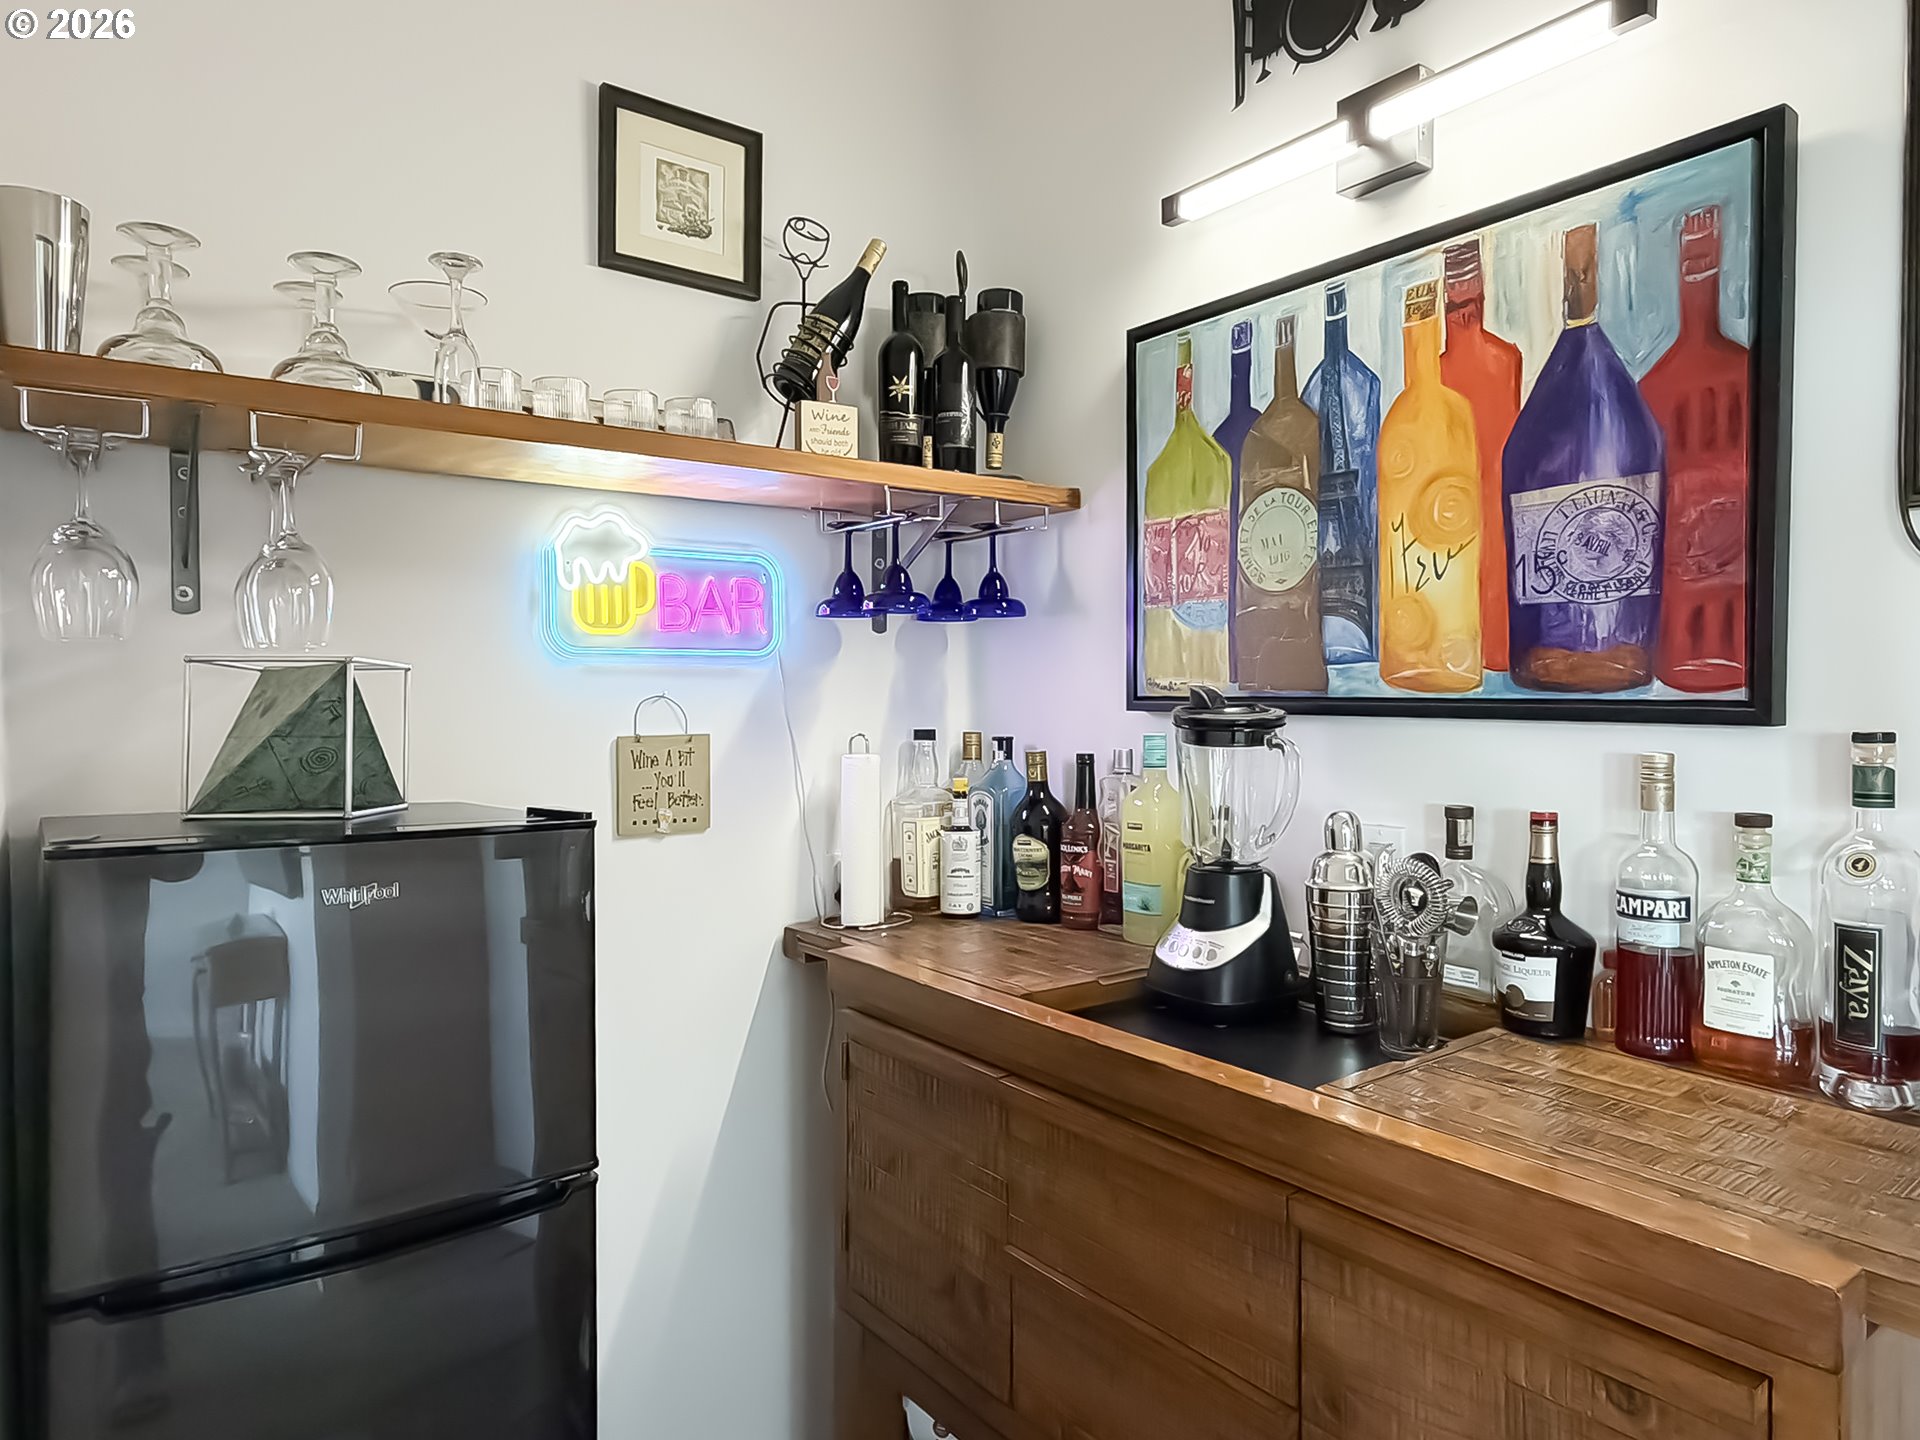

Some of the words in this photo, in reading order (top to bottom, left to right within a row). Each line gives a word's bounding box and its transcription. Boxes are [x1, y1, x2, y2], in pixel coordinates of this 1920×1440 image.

[811, 408, 851, 422] Wine
[1280, 491, 1311, 516] TOUR
[656, 572, 767, 634] BAR
[630, 749, 660, 770] Wine
[664, 749, 674, 768] A
[632, 791, 658, 813] Feel
[321, 881, 400, 910] Whirlpool
[1513, 965, 1552, 977] LIQUEUR
[1706, 960, 1742, 970] APPLETON
[1741, 961, 1771, 980] ESTATE
[1839, 944, 1874, 1021] Zaya
